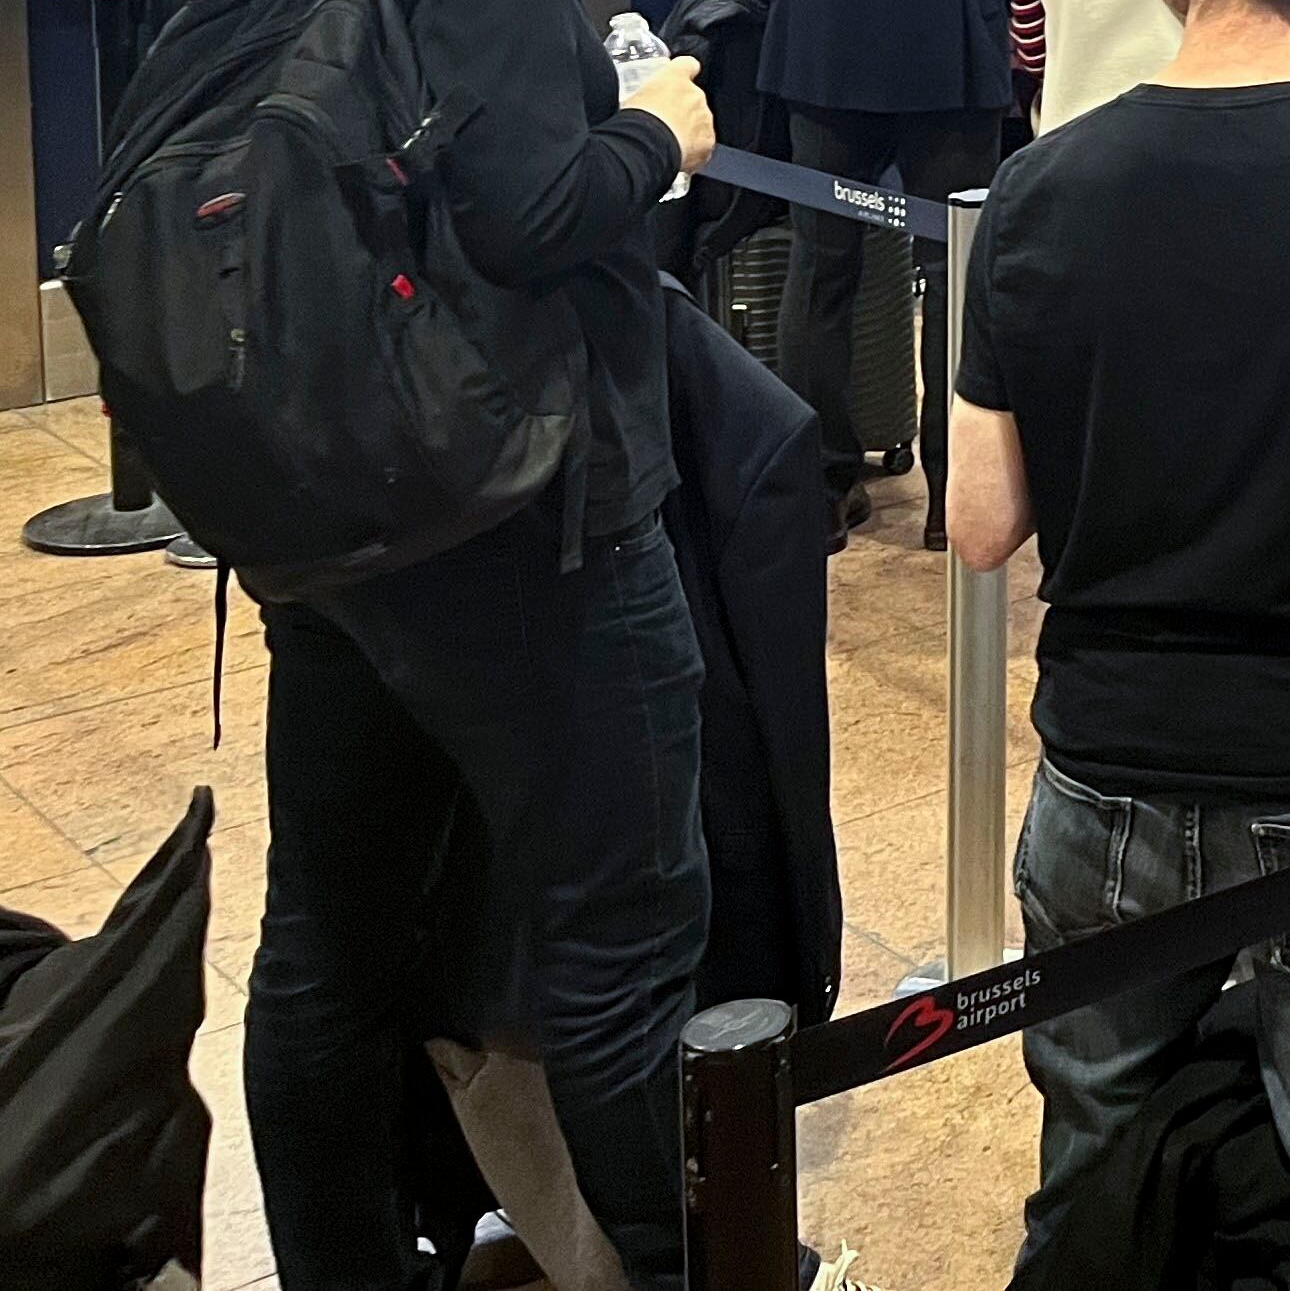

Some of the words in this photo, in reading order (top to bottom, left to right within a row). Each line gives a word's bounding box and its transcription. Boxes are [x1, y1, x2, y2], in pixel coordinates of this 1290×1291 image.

[834, 180, 885, 211] brussels
[956, 969, 1041, 1010] brussels
[956, 993, 1027, 1030] airport
